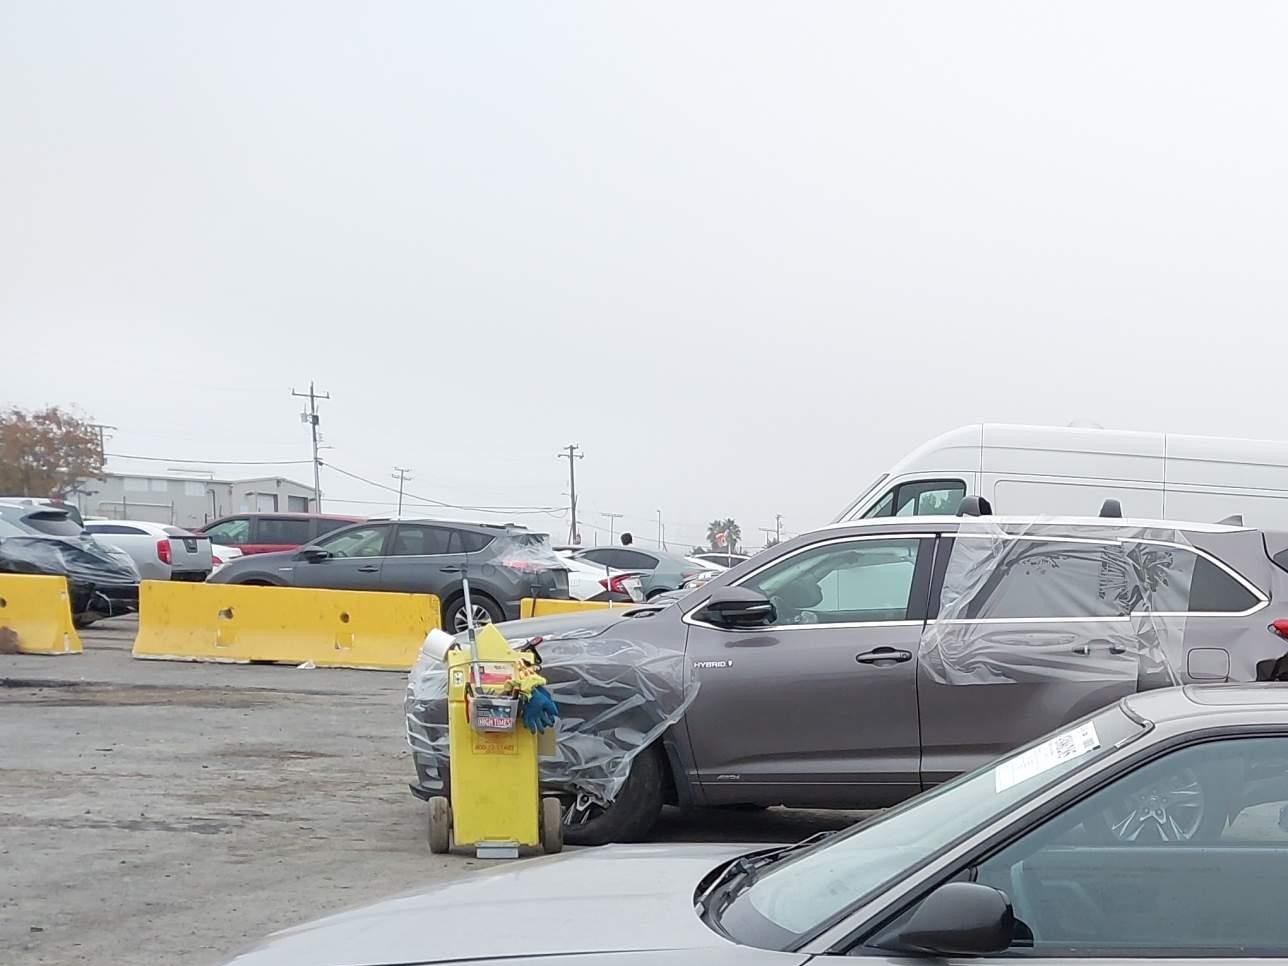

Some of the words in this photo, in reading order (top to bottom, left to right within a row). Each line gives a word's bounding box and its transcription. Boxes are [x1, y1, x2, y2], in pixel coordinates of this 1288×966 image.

[693, 660, 726, 668] HYBRID
[479, 718, 493, 728] HIGH
[493, 718, 512, 729] TIMES
